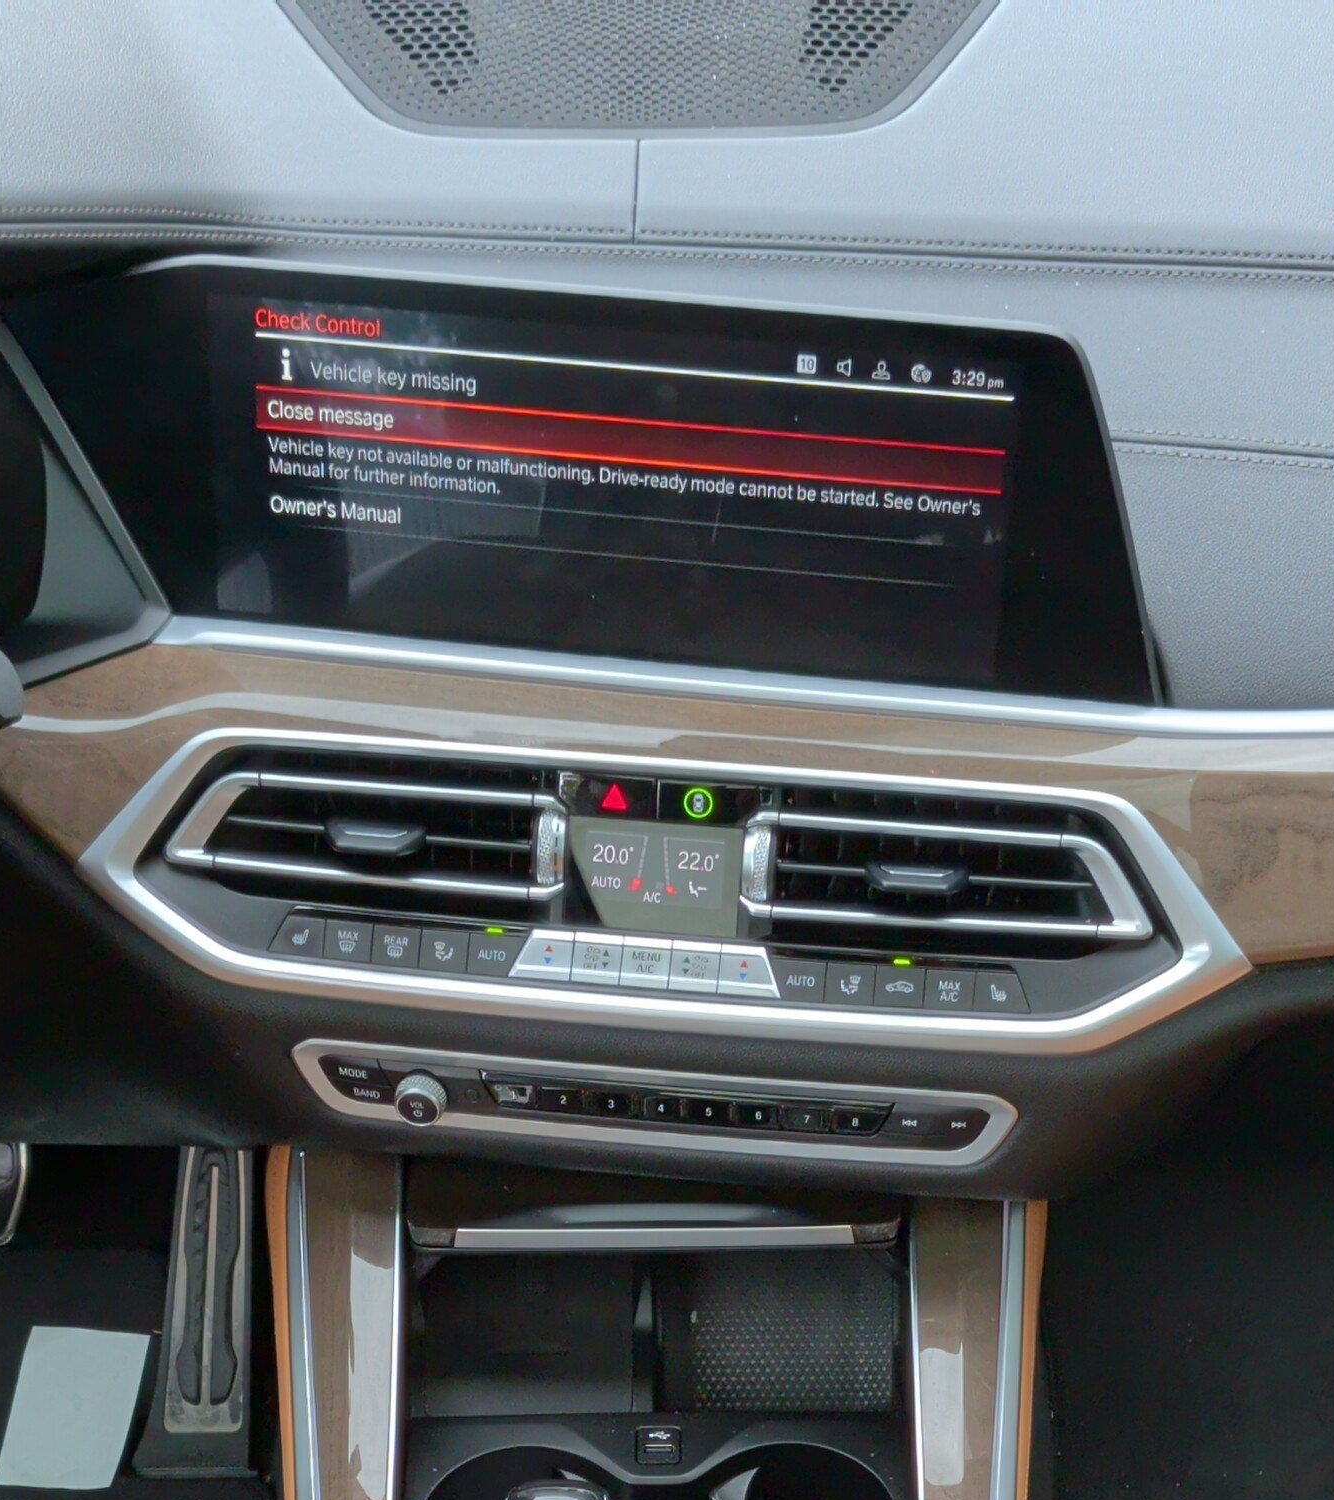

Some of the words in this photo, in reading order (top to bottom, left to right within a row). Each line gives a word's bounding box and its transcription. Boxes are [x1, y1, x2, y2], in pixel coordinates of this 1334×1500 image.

[255, 308, 310, 332] Check
[316, 313, 381, 338] Control
[311, 360, 372, 384] Vehicle
[377, 365, 405, 391] key
[411, 370, 477, 397] missing
[952, 368, 985, 388] 3:29
[988, 377, 1005, 390] pm
[267, 399, 314, 420] Close
[319, 406, 394, 433] message
[268, 436, 323, 457] Vehicle
[328, 442, 353, 463] key
[358, 446, 383, 464] not
[386, 448, 452, 471] available
[457, 456, 472, 471] or
[477, 456, 595, 485] malfunctioning.
[599, 465, 687, 494] Drive-ready
[691, 475, 734, 496] mode
[739, 481, 793, 501] cannot
[797, 484, 816, 503] be
[820, 487, 879, 508] started.
[883, 491, 913, 511] See
[917, 494, 981, 517] Owner's
[269, 458, 324, 479] Manual
[328, 462, 350, 481] for
[353, 466, 406, 487] further
[409, 471, 501, 496] information.
[270, 495, 336, 520] Owner's
[341, 501, 401, 525] Manual
[591, 874, 621, 890] AUTO
[642, 891, 661, 904] A/C
[337, 929, 359, 942] MAX
[383, 934, 409, 948] REAR
[477, 948, 506, 962] AUTO
[632, 950, 661, 962] MENU
[786, 974, 815, 988] AUTO
[938, 979, 961, 993] MAX
[939, 990, 959, 1003] A/C
[338, 1066, 368, 1080] MODE
[352, 1086, 381, 1100] BAND
[409, 1101, 424, 1110] VOL
